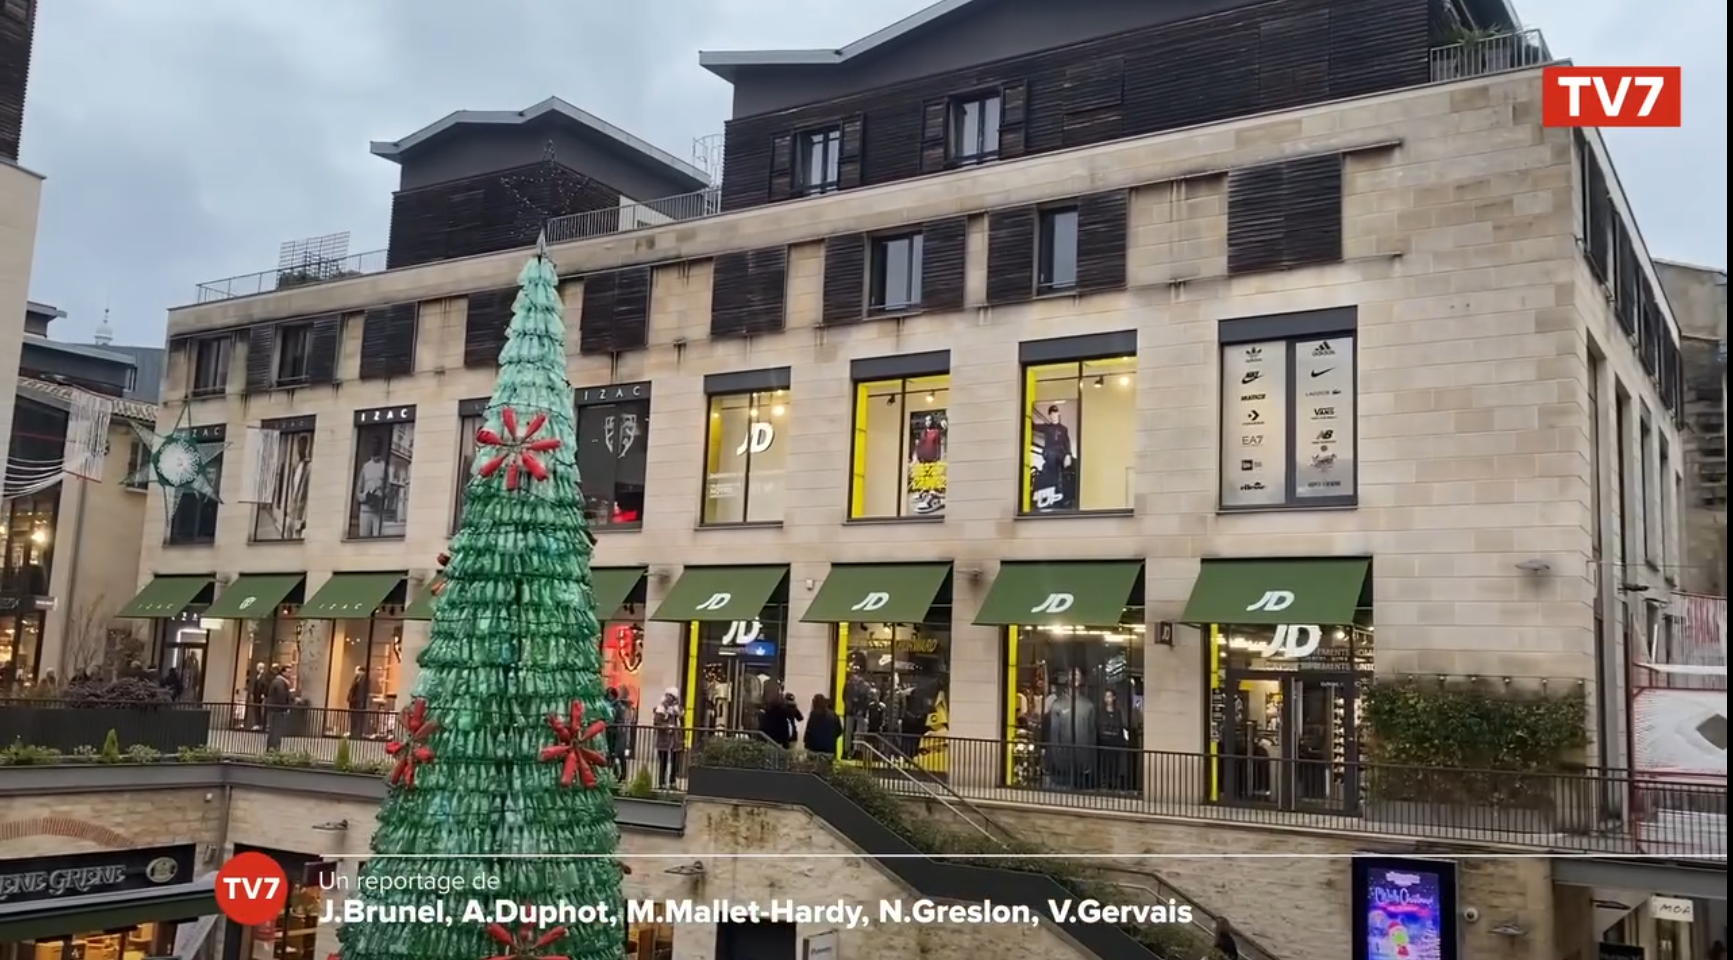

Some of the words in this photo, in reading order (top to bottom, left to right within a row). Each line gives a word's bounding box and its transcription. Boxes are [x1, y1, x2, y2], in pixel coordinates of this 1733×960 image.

[584, 386, 640, 400] IZAC
[361, 409, 408, 422] IZAC
[1314, 407, 1334, 415] VANS
[736, 422, 773, 456] JD
[1242, 435, 1263, 446] EA7
[695, 593, 731, 610] JD
[851, 592, 889, 611] JD
[1031, 593, 1074, 613] JD
[1246, 590, 1295, 611] JD
[721, 620, 761, 645] JD
[1161, 626, 1170, 640] JD
[1260, 624, 1322, 658] JD
[0, 872, 48, 900] ENE
[49, 865, 127, 895] GRENE
